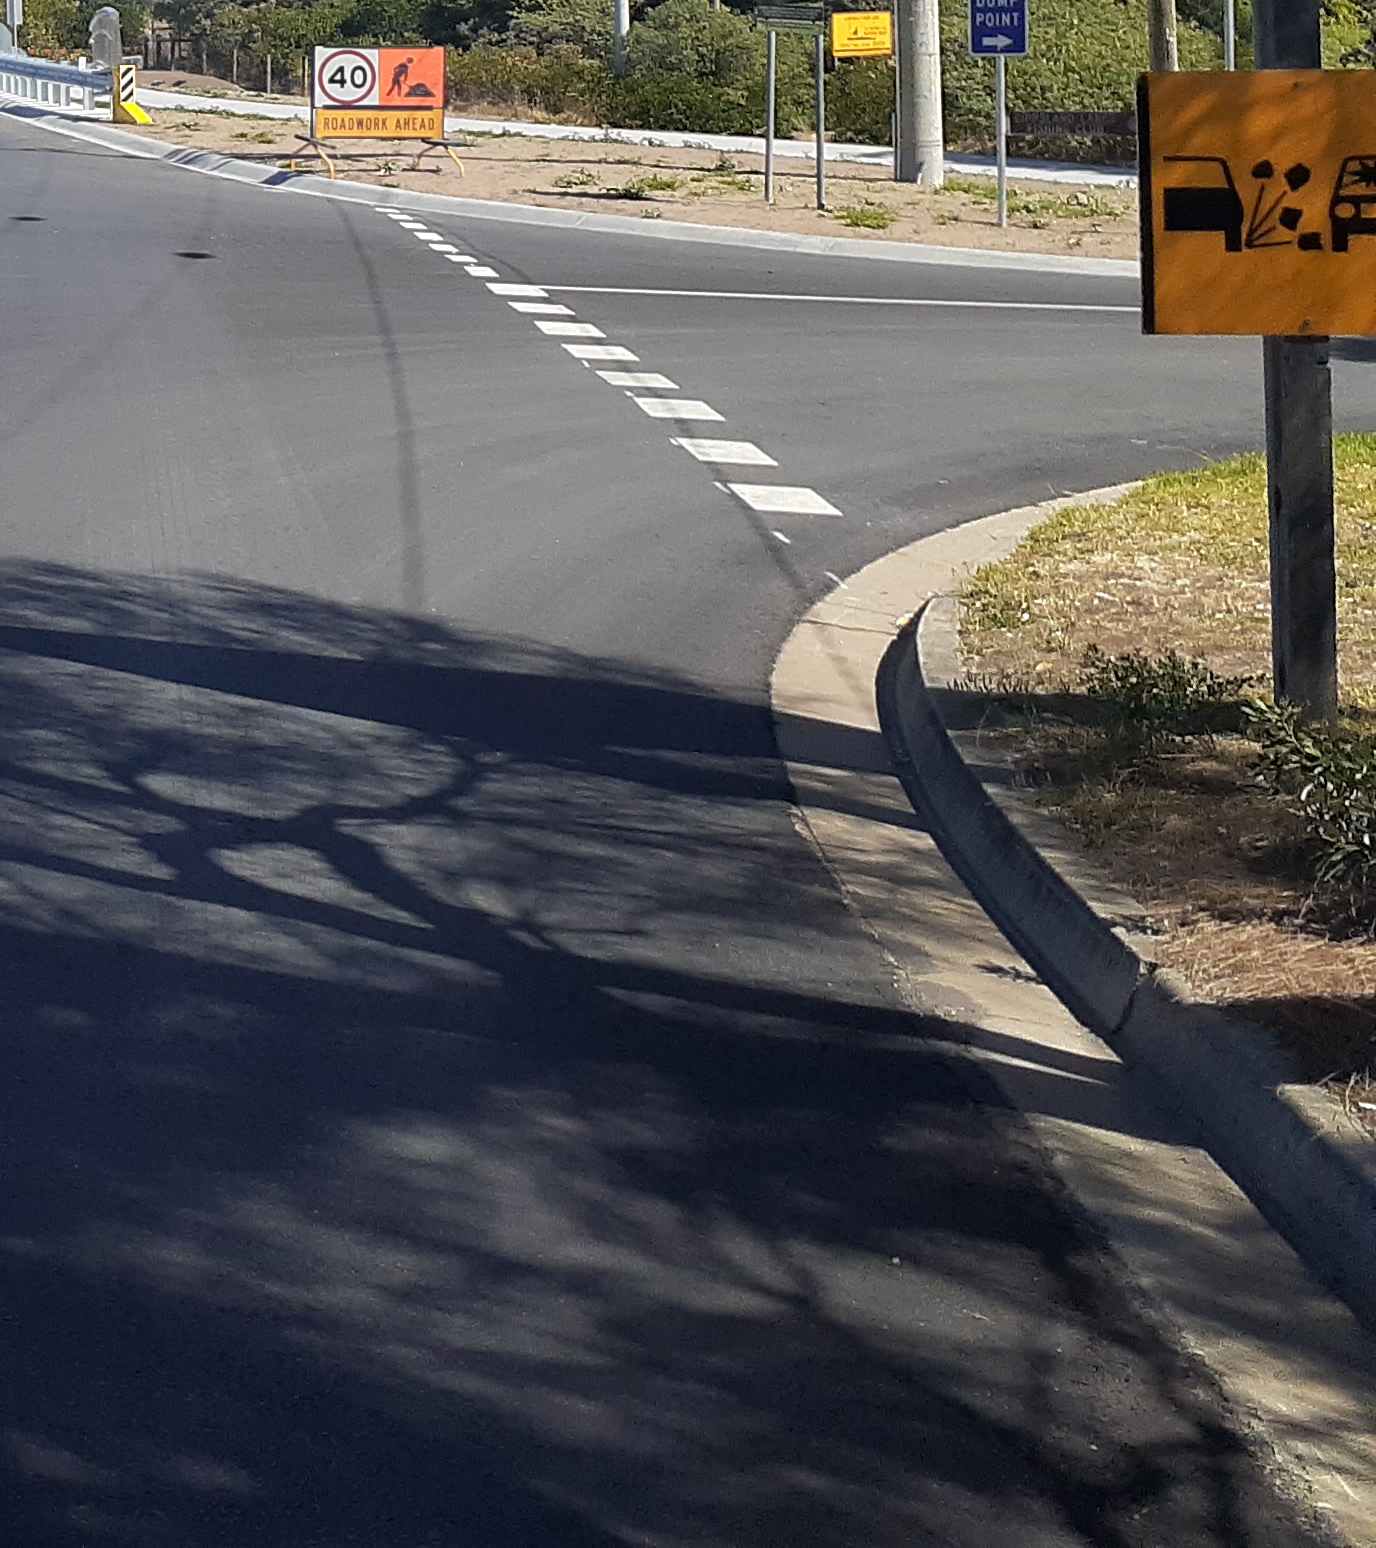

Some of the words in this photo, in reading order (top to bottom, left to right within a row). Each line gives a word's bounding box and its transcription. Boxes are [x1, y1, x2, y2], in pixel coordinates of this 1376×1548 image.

[975, 12, 1020, 27] POINT
[327, 65, 368, 89] 40
[323, 117, 388, 131] ROADWORK
[395, 117, 435, 131] AHEAD
